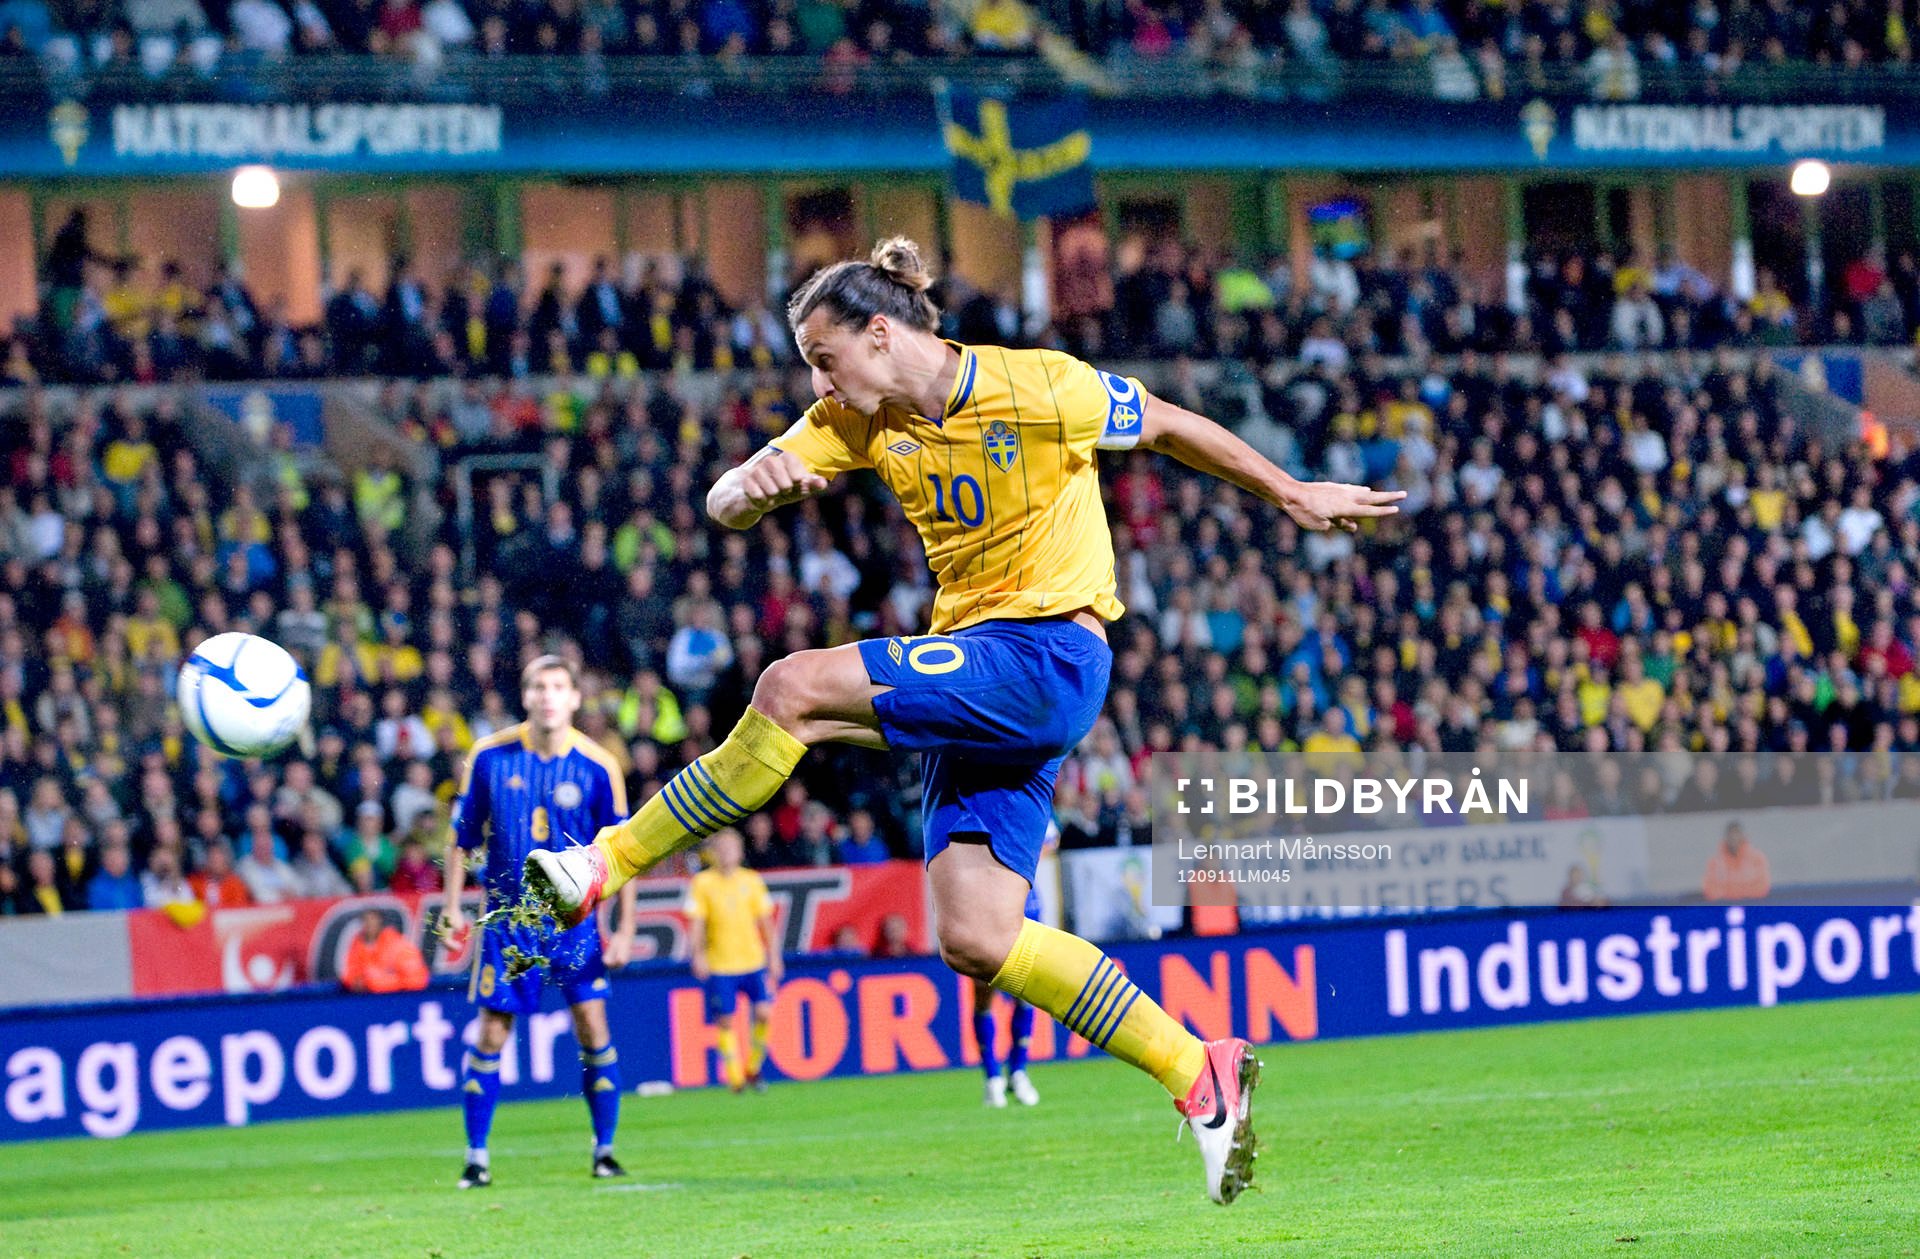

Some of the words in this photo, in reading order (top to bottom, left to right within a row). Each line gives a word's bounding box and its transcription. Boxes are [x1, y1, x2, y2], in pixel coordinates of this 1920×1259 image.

[112, 103, 501, 155] NATIONALSPORTEN
[1572, 104, 1886, 152] NATIONALSPORTEN
[928, 473, 985, 528] 10
